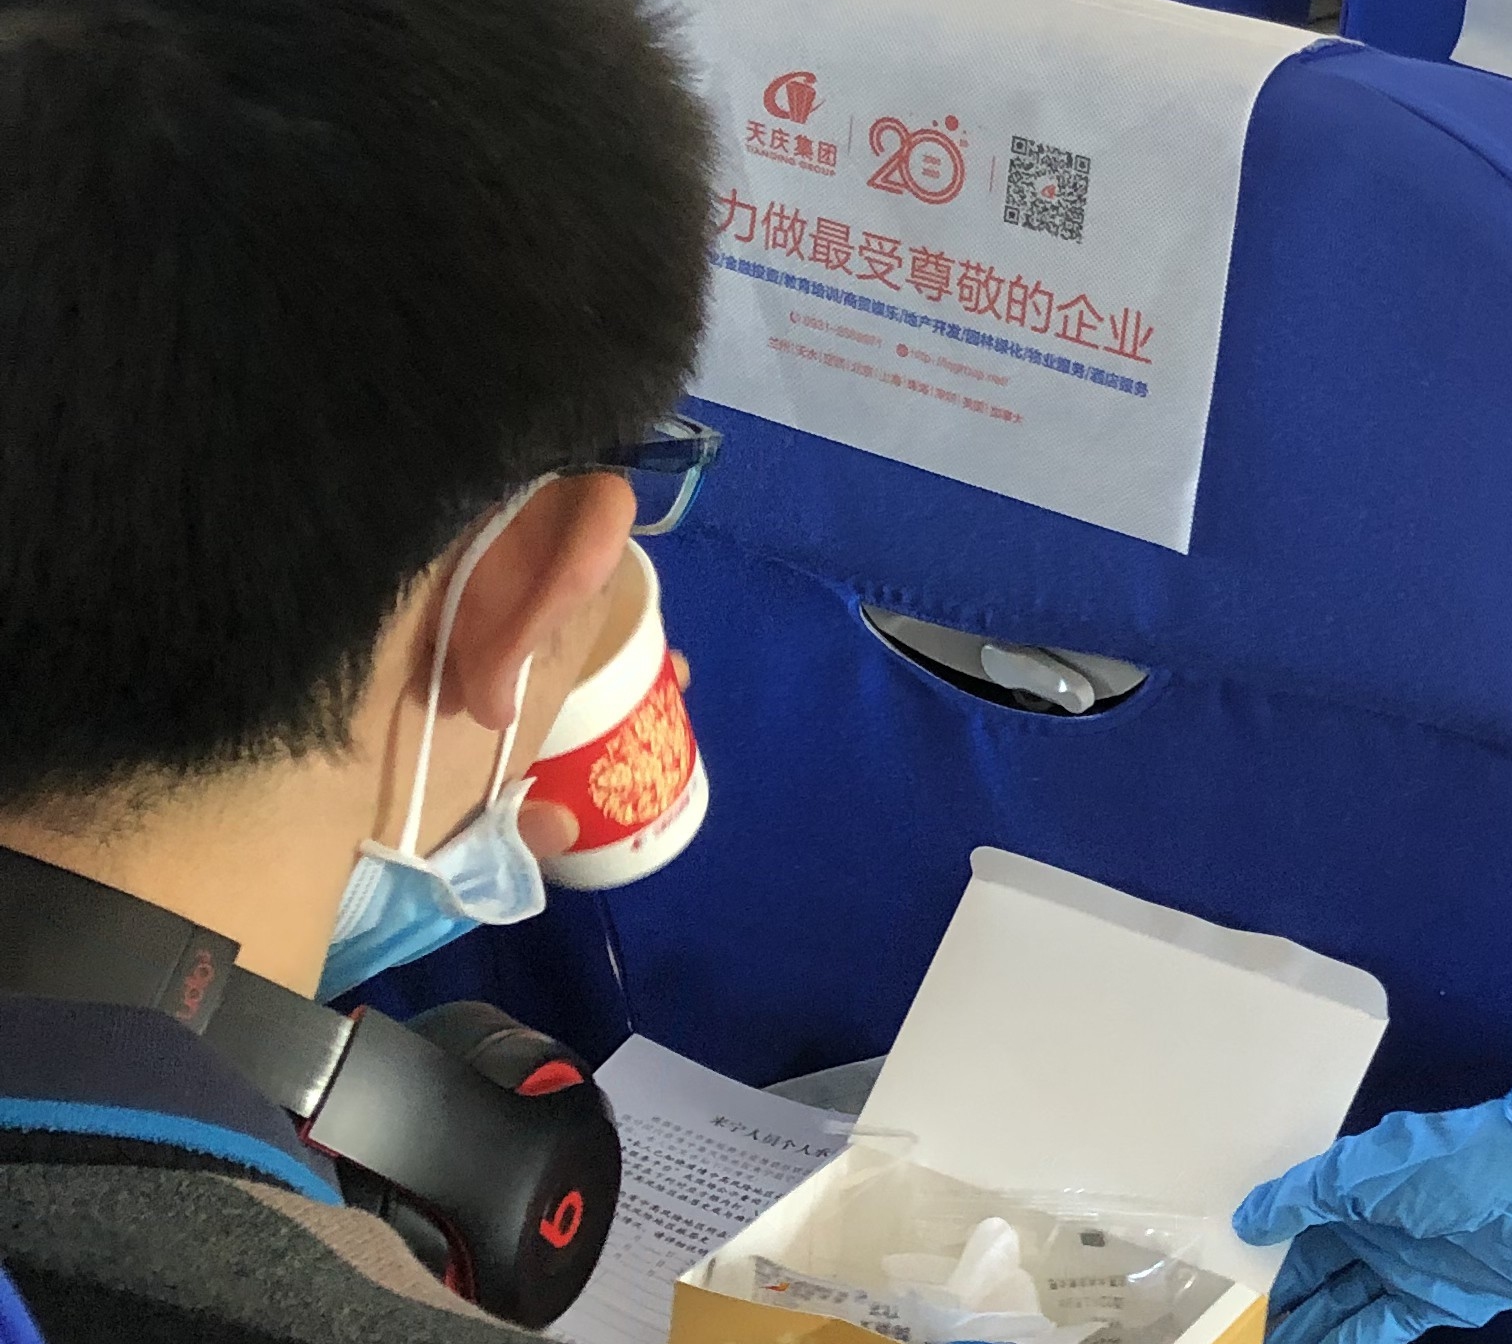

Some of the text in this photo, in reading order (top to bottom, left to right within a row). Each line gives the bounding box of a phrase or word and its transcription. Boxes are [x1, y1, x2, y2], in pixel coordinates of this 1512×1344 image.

[746, 119, 838, 167] 天庆集团
[866, 116, 965, 205] 20
[716, 188, 1154, 365] 力做最受尊敬的企业
